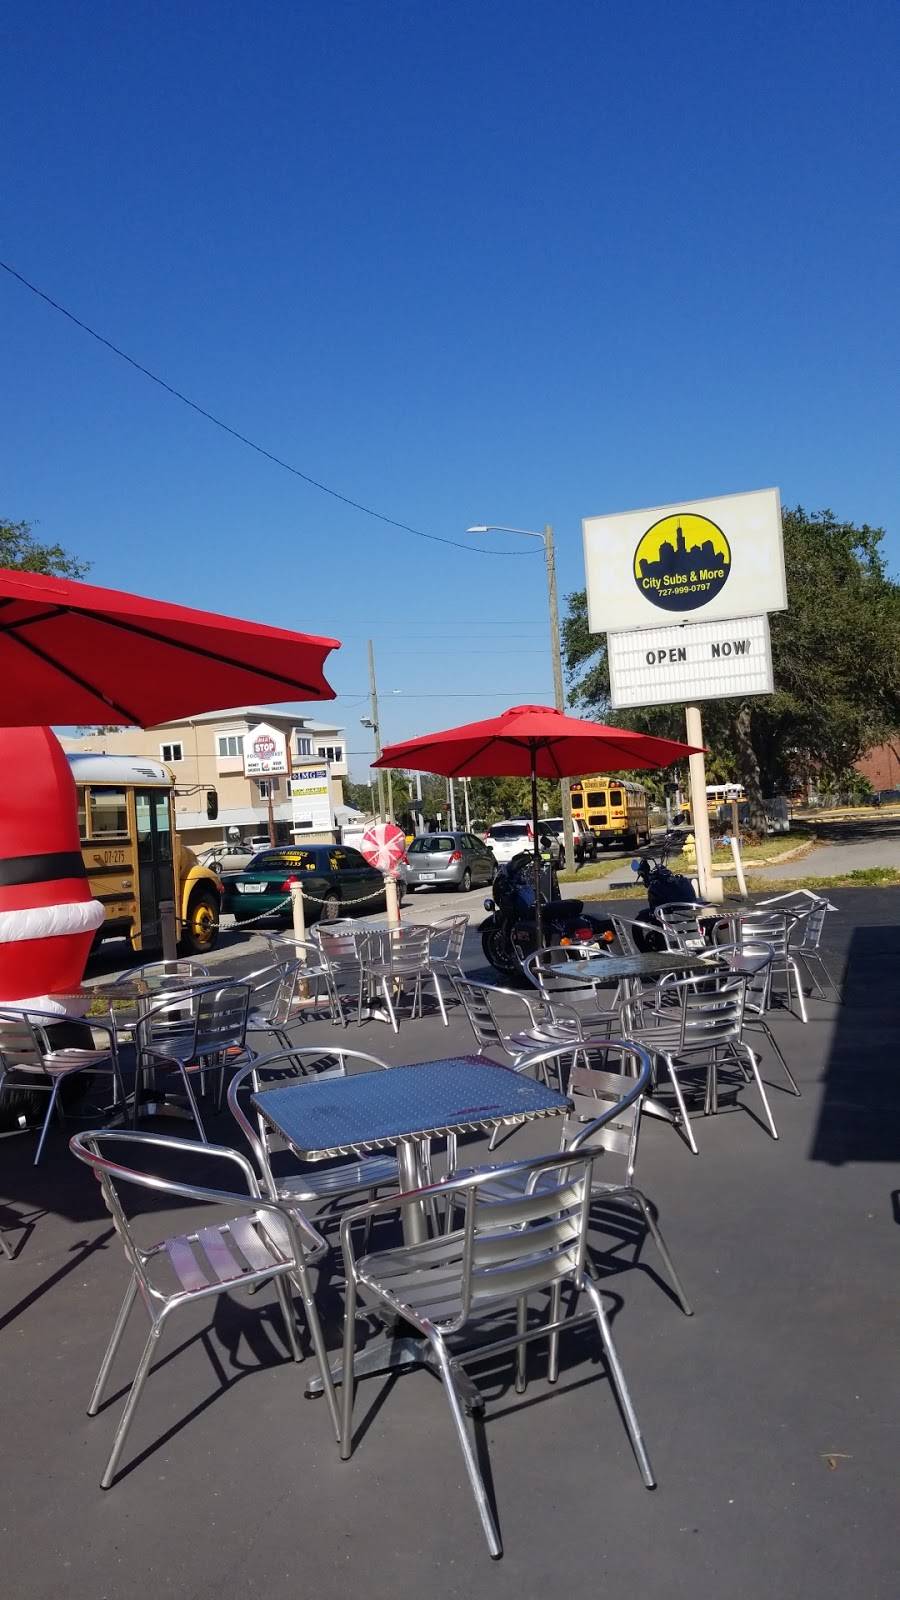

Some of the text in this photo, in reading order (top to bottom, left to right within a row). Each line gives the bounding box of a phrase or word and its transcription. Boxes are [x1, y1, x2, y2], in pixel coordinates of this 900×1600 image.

[642, 569, 724, 590] City Subs & More
[646, 640, 746, 665] OPEN NOW
[255, 743, 274, 752] STOP
